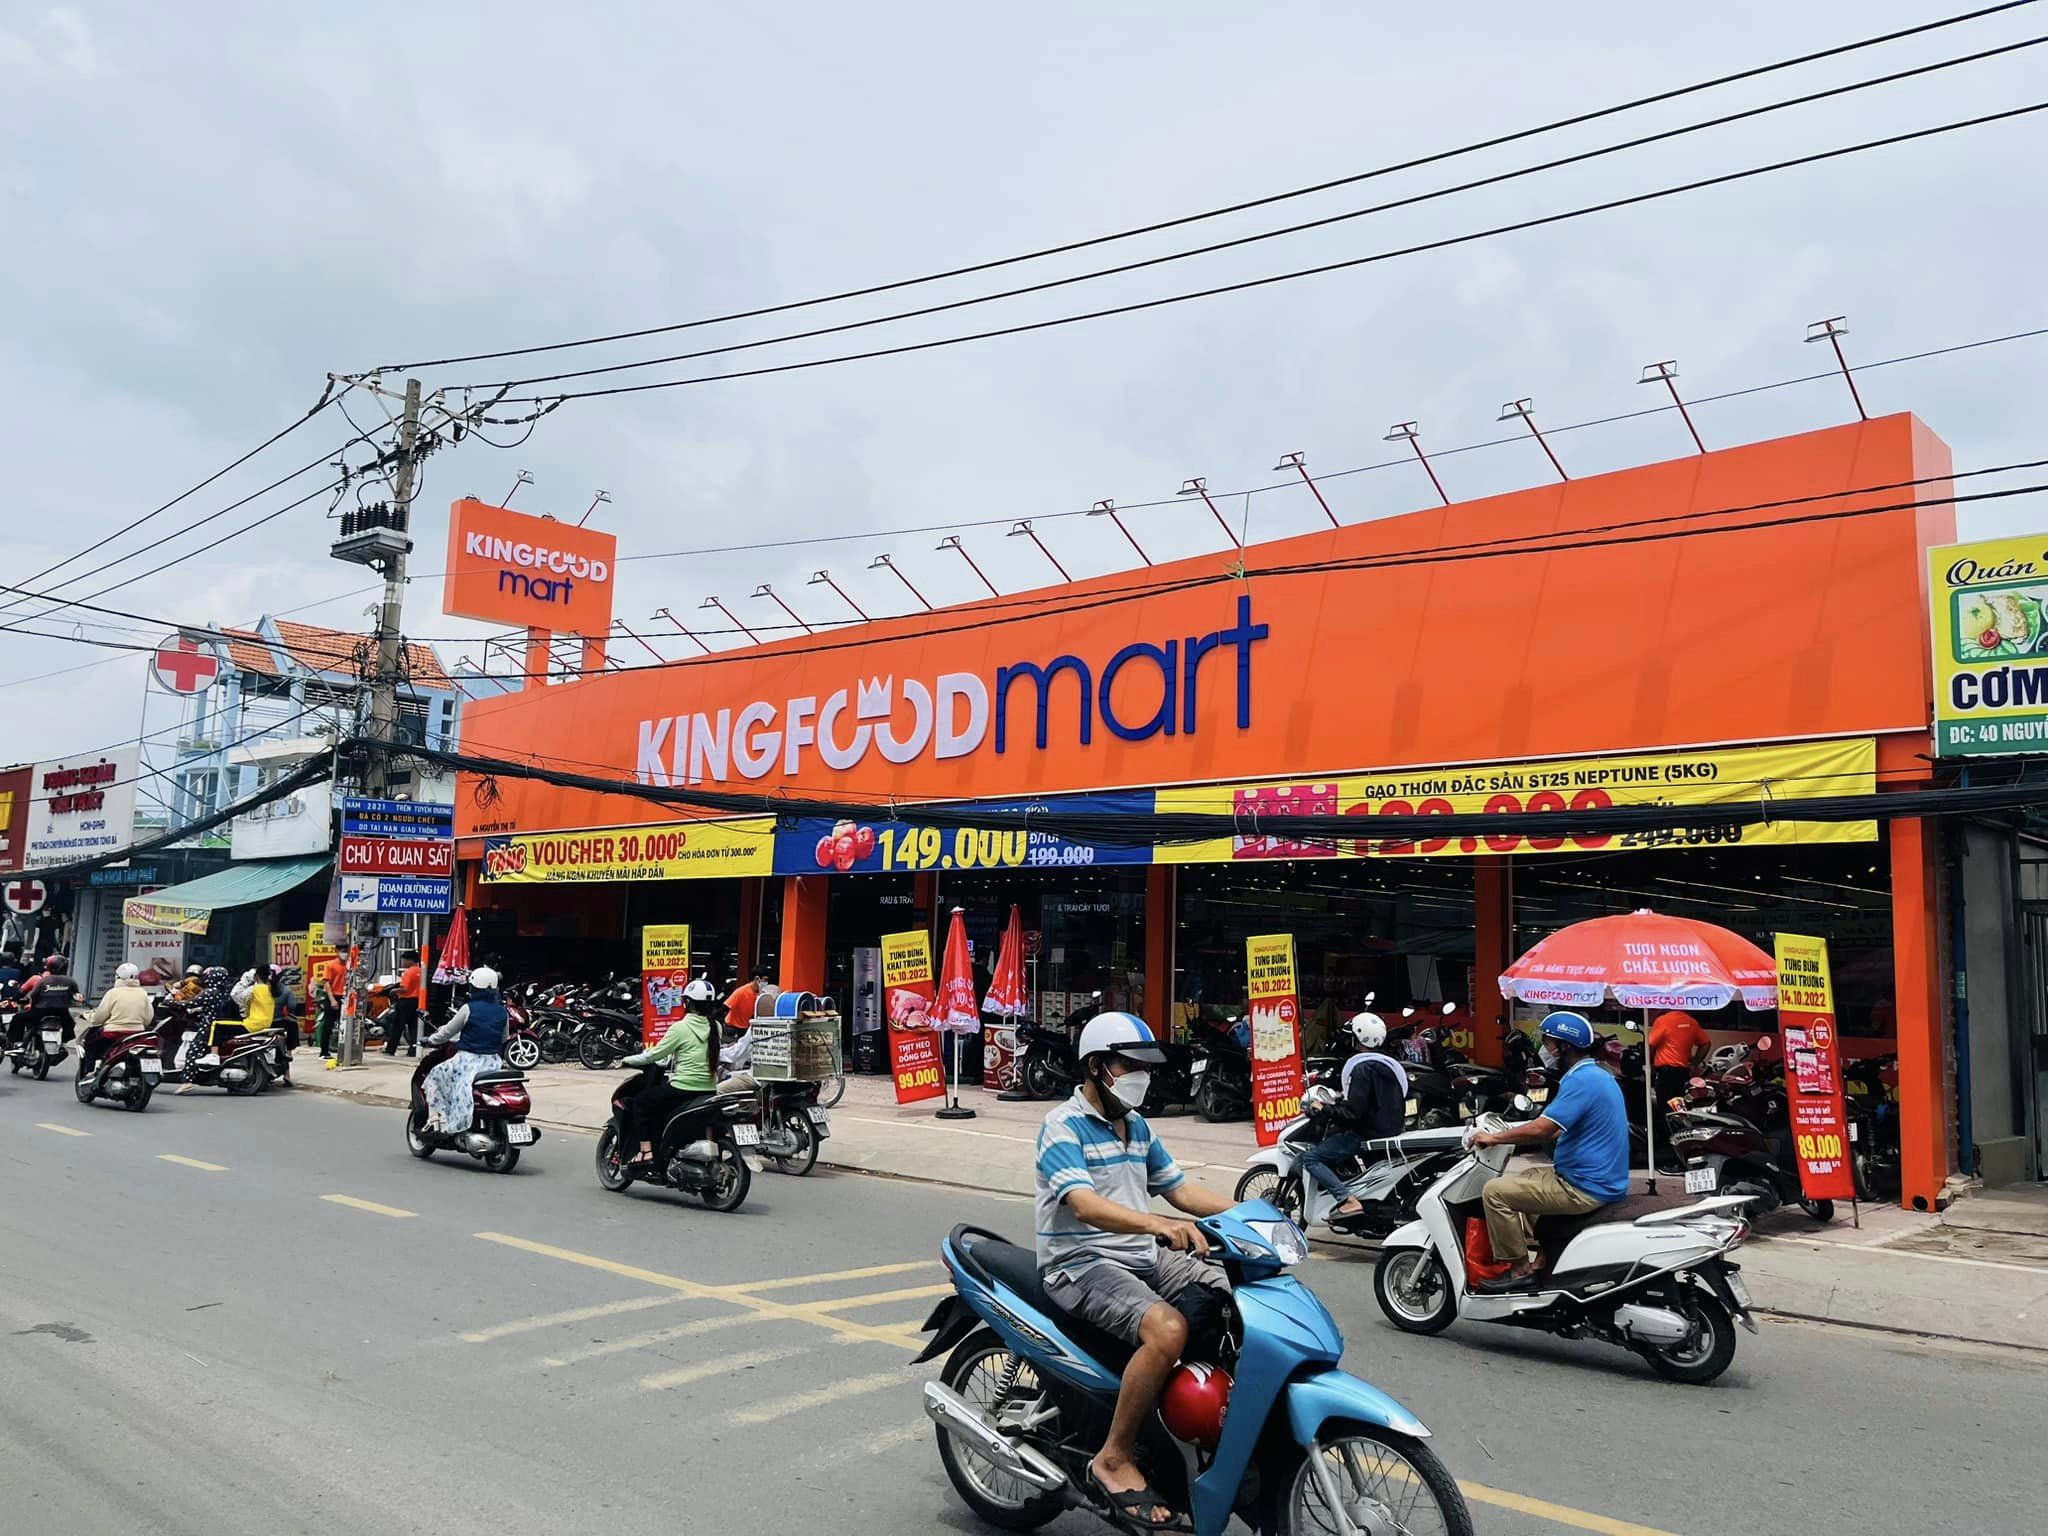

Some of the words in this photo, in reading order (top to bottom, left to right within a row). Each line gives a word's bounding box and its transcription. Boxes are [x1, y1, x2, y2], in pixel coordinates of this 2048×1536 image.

[466, 531, 608, 582] KINGFOOD
[1945, 557, 2038, 587] Quán
[498, 569, 573, 605] mart
[1951, 666, 2048, 710] CƠM
[1979, 724, 1998, 742] 40
[1365, 784, 1397, 801] GẠO
[1400, 779, 1447, 797] THƠM
[1451, 775, 1485, 796] ĐẶC
[1490, 771, 1523, 790] SẢN
[1529, 772, 1569, 788] ST25
[1574, 766, 1659, 785] NEPTUNE
[1664, 762, 1718, 783] (5KG)
[345, 841, 372, 864] CHÚ
[376, 841, 385, 865] Ý
[388, 846, 424, 866] QUAN
[428, 844, 450, 866] SÁT
[532, 837, 615, 866] VOUCHER
[677, 850, 691, 860] CHO
[878, 825, 1028, 871] 149.000
[1028, 846, 1094, 866] 199.000
[586, 866, 615, 880] KHUYẾN
[631, 863, 647, 879] HẤP
[433, 885, 449, 895] HAY
[400, 898, 412, 908] RA
[413, 899, 427, 908] TAI
[274, 942, 300, 966] HEO
[646, 949, 661, 957] KHAI
[1659, 943, 1700, 956] NGON
[646, 957, 685, 968] 14.10.2022
[887, 961, 904, 971] KHAI
[1623, 956, 1658, 974] CHẤT
[1662, 960, 1711, 976] LƯỢNG
[887, 968, 928, 983] 14.10.2022
[1250, 968, 1266, 979] KHAI
[1780, 973, 1797, 986] KHAI
[1251, 978, 1292, 994] 14.10.2022
[1781, 989, 1826, 1008] 14.10.2022
[915, 1040, 931, 1050] HEO
[898, 1067, 939, 1089] 99.000
[1258, 1096, 1300, 1121] 49.000
[1797, 1134, 1842, 1159] 89.000
